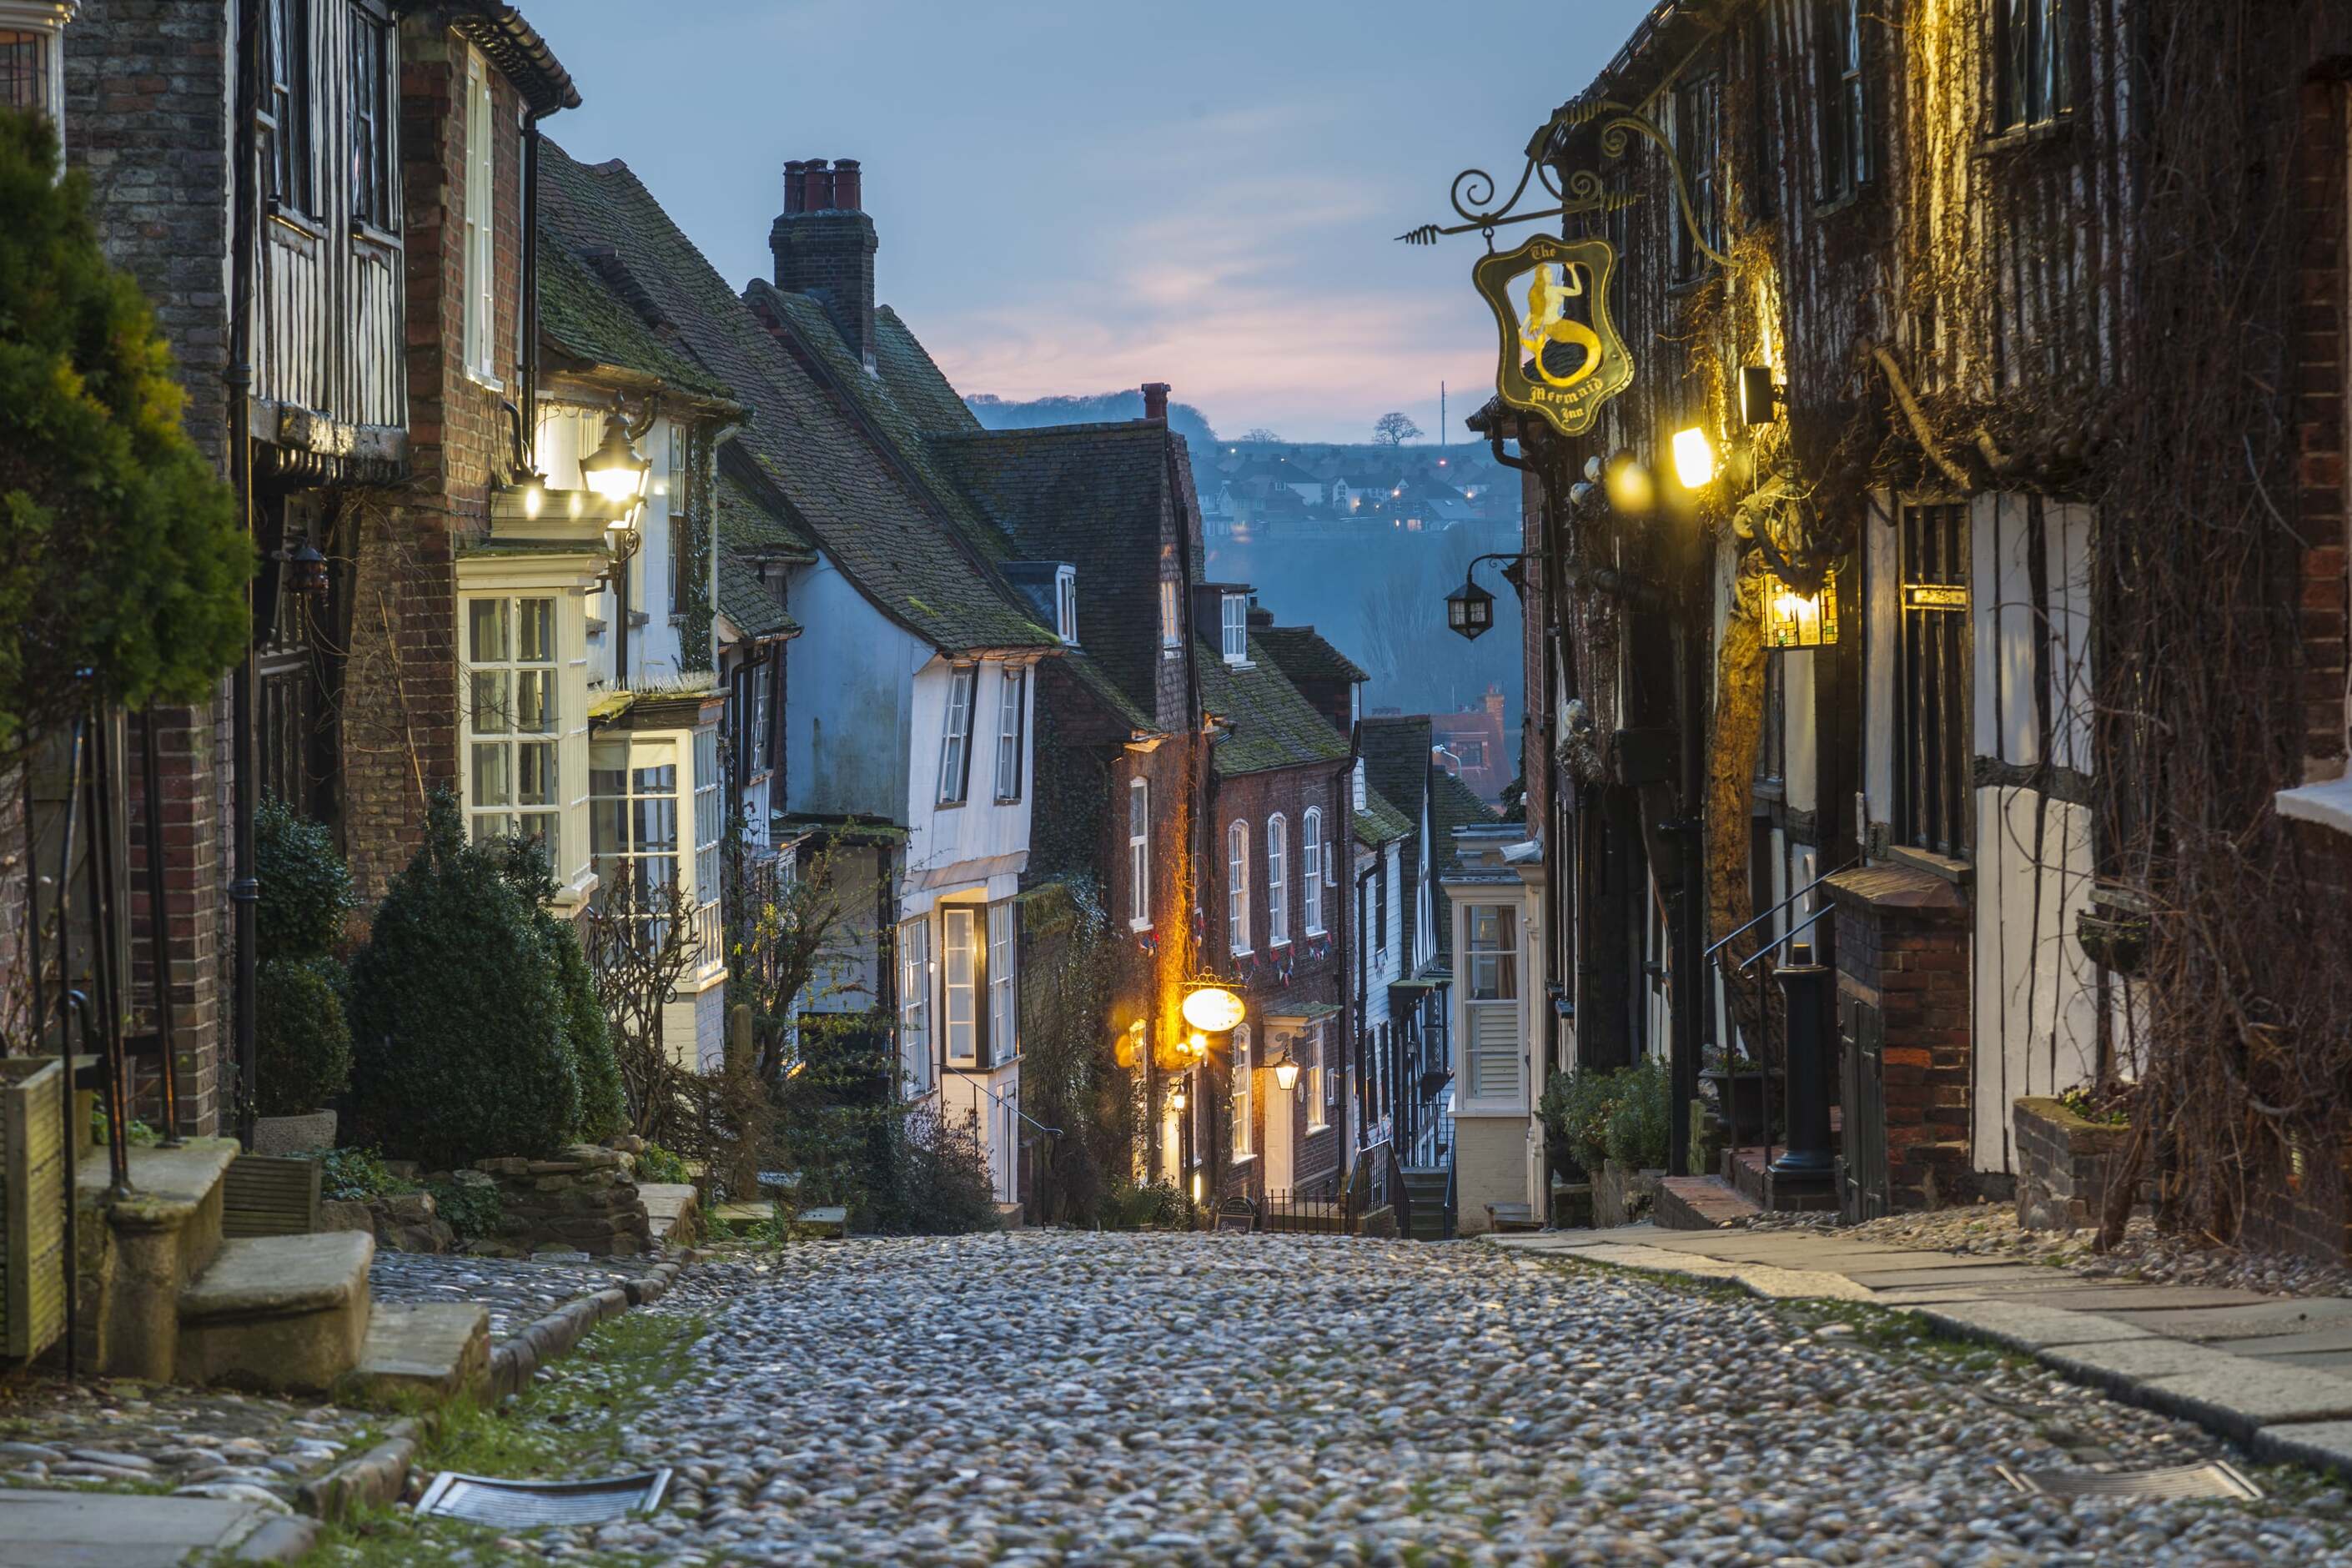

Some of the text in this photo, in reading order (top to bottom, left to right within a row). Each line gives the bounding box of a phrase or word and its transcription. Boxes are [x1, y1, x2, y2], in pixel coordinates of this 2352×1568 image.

[1530, 244, 1556, 260] The
[1529, 377, 1603, 404] Mermaid
[1560, 407, 1584, 425] Inn
